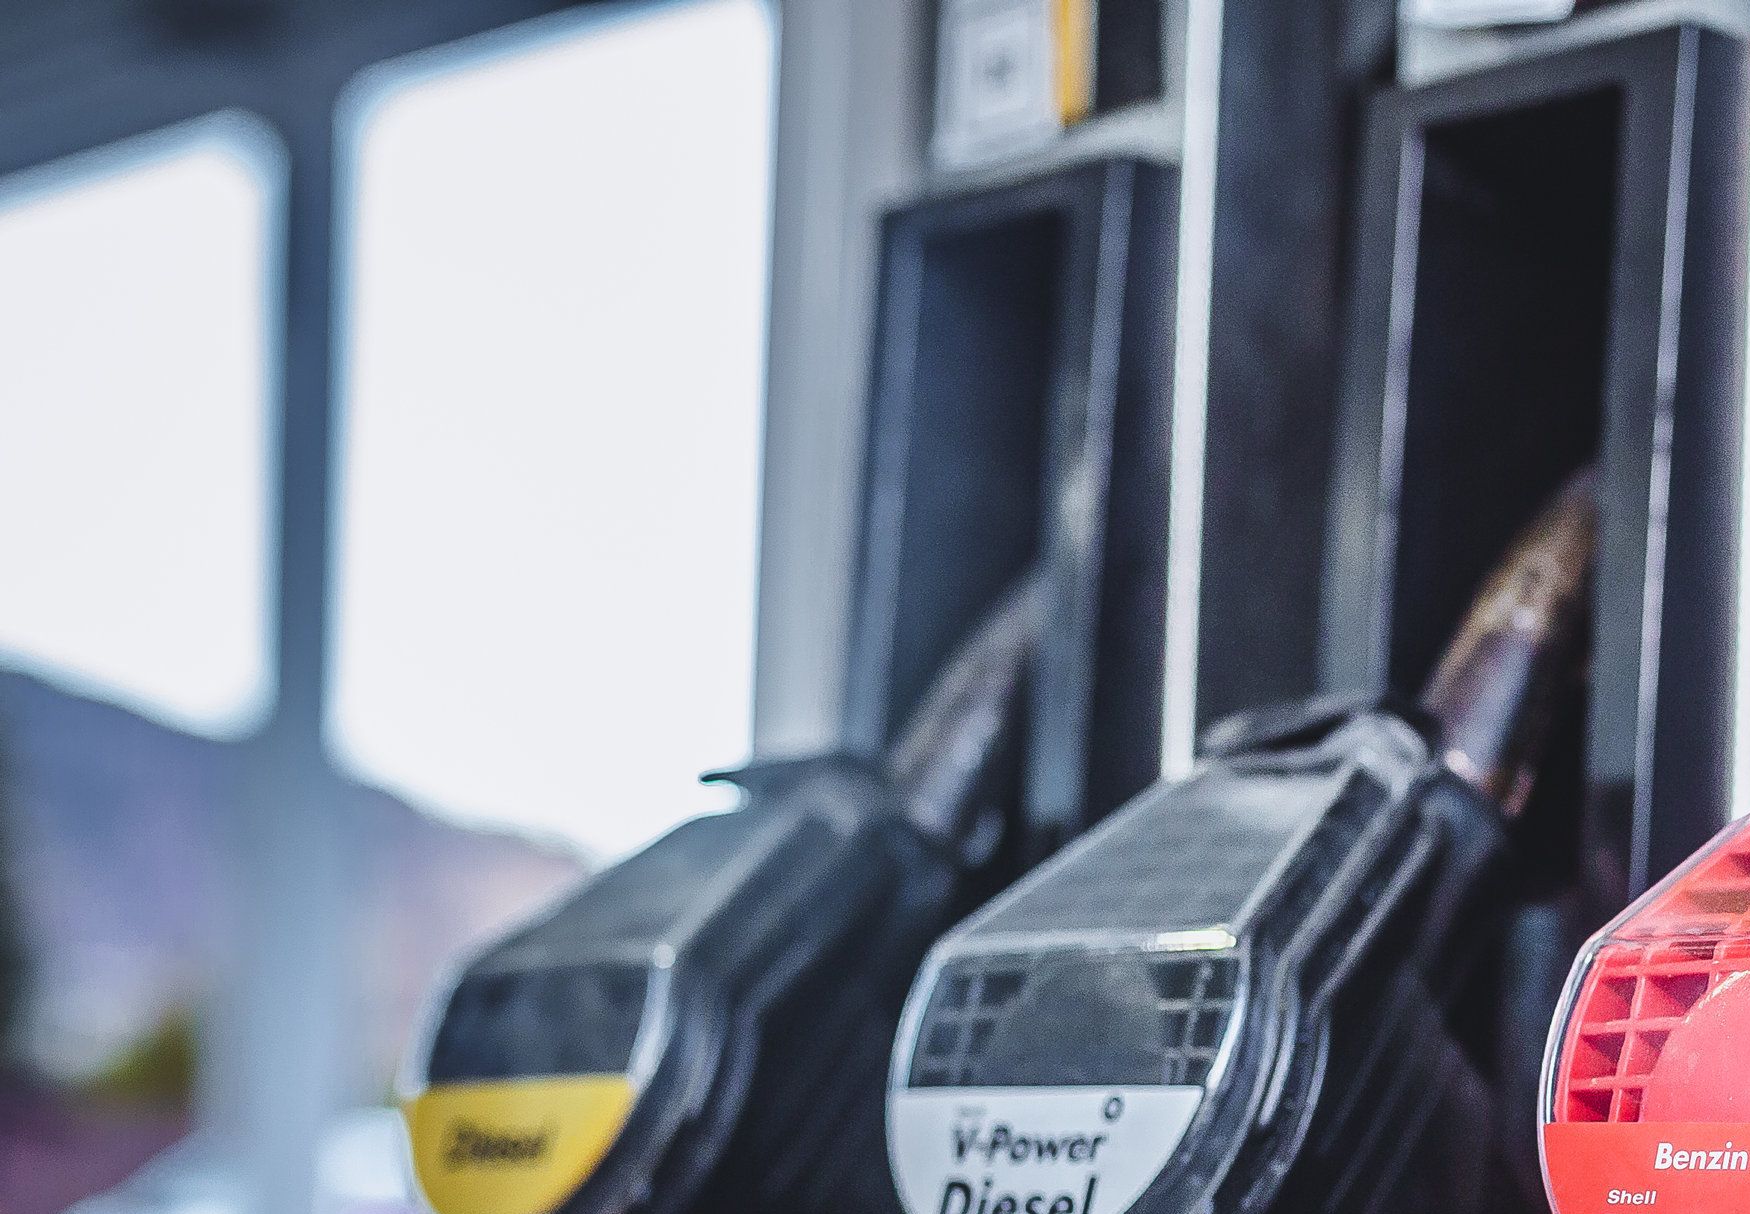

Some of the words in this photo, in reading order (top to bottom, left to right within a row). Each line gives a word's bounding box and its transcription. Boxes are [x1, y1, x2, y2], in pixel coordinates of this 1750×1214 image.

[953, 1121, 1108, 1163] V-Power
[1654, 1141, 1747, 1171] Benzin
[1607, 1189, 1657, 1205] Shell
